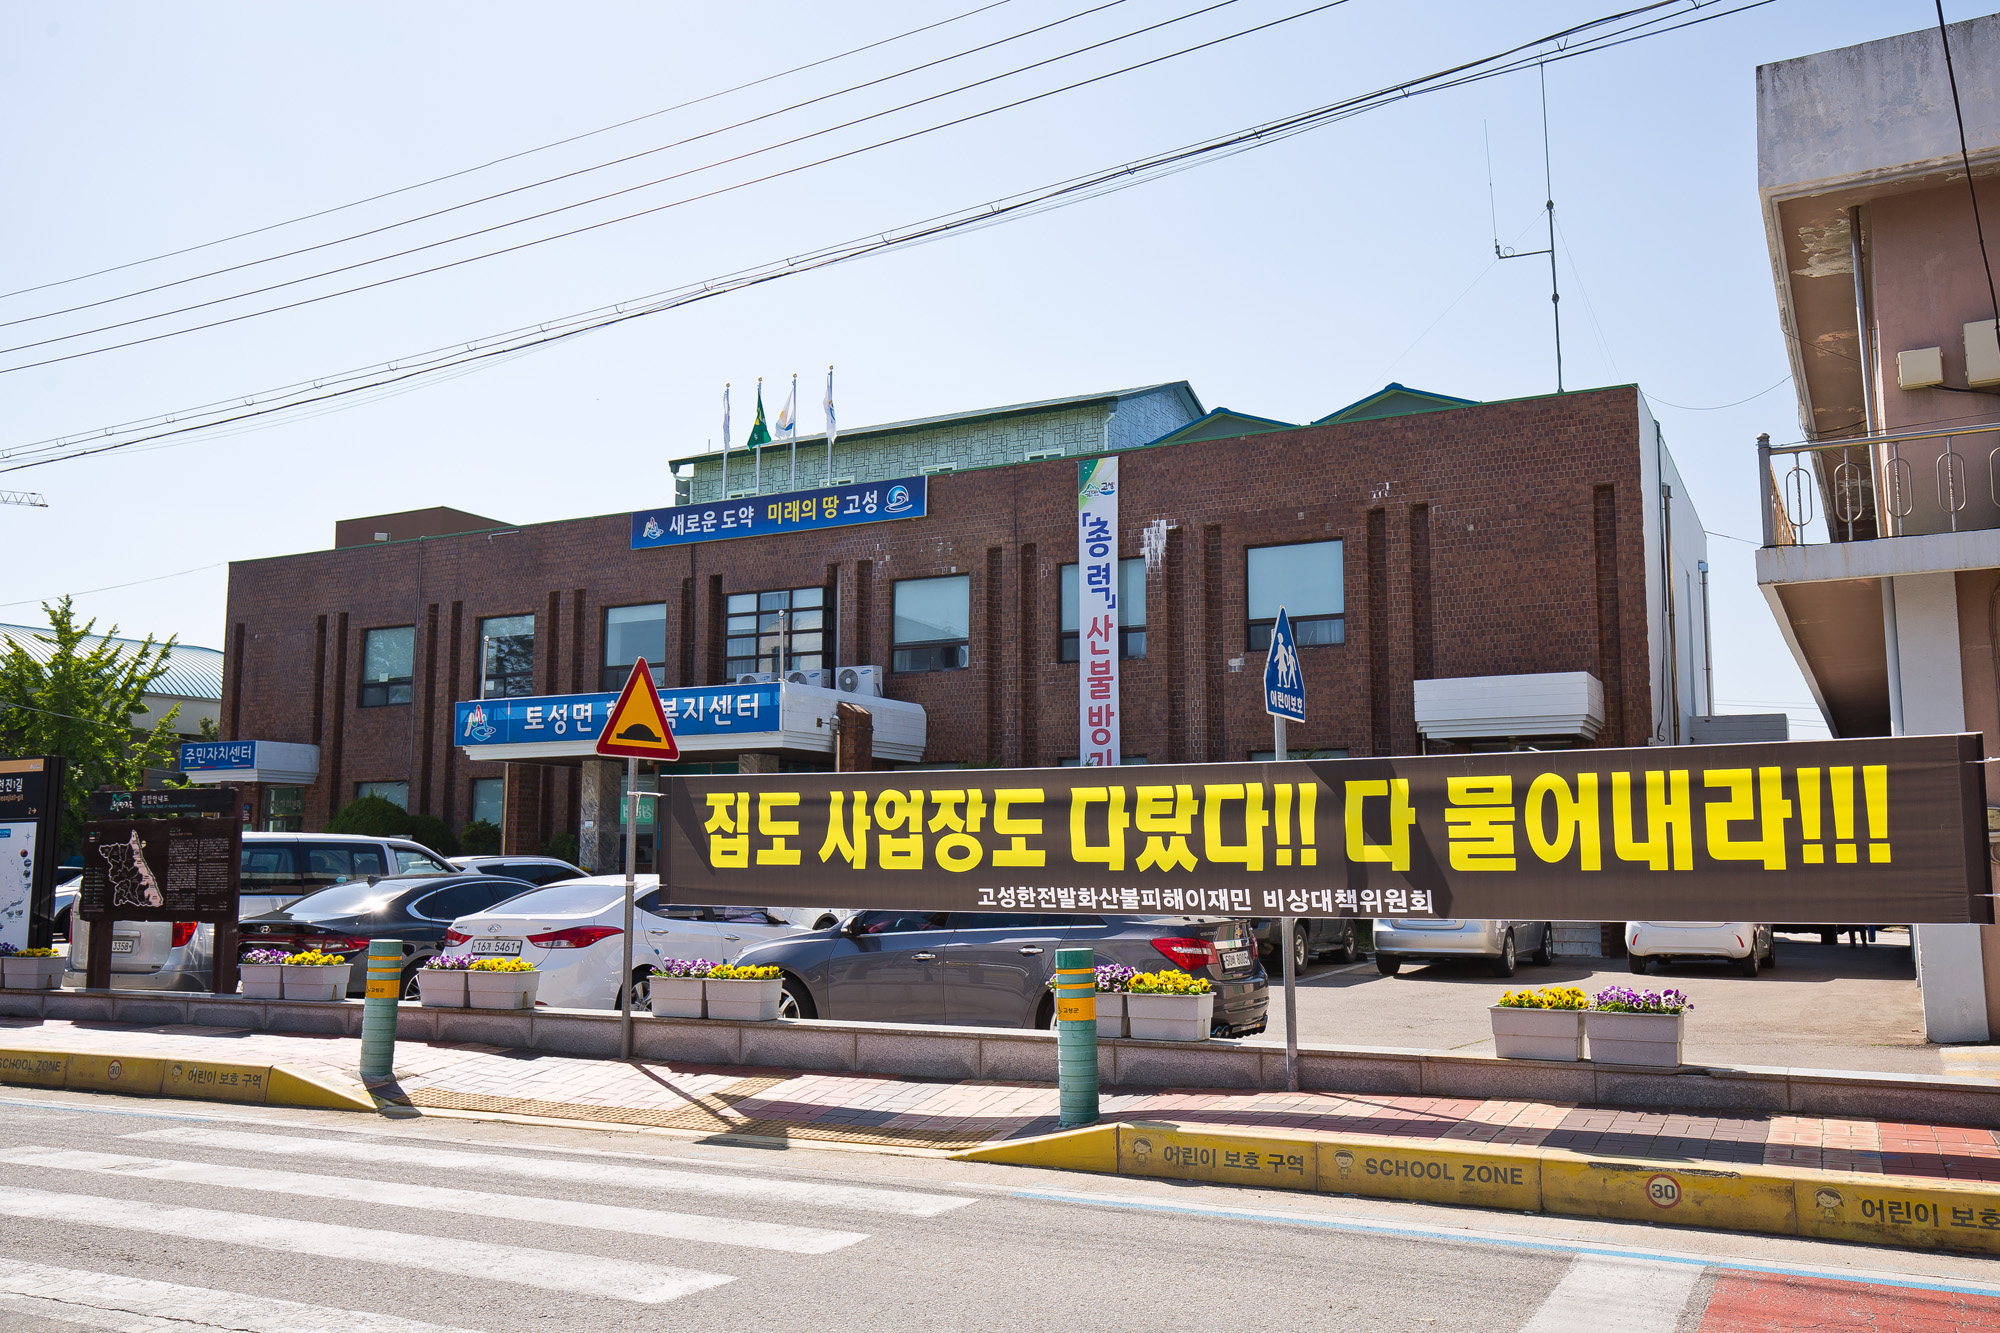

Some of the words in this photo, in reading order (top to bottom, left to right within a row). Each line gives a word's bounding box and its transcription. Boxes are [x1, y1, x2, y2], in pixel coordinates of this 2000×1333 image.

[669, 510, 717, 536] 새로운
[721, 506, 754, 529] 도약
[768, 497, 817, 525] 미래의
[822, 495, 839, 518] 땅
[843, 490, 879, 515] 고성
[524, 702, 593, 735] 토성면
[606, 693, 760, 729] 복지센터
[1270, 690, 1304, 714] 어린이보호
[184, 745, 252, 764] 주민자치센터
[704, 791, 801, 869] 집도
[818, 788, 1046, 873] 사업장도
[1069, 782, 1318, 873] 다탔다!!
[1344, 778, 1416, 872] 다
[1445, 764, 1892, 872] 물어내라!!!
[978, 886, 1251, 912] 고성한전발화산불피해이재민
[1263, 888, 1434, 914] 비상대책위원회
[495, 942, 515, 951] 5461
[35, 1060, 61, 1073] ZONE
[110, 1066, 119, 1076] 30
[187, 1068, 217, 1086] 어린이
[218, 1072, 239, 1085] 보호
[242, 1073, 263, 1089] 구역
[1163, 1146, 1217, 1168] 어린이
[1223, 1151, 1261, 1170] 보호
[1267, 1154, 1304, 1175] 구역
[1365, 1158, 1455, 1181] SCHOOL
[1462, 1164, 1523, 1185] ZONE
[1651, 1184, 1675, 1199] 30
[1861, 1199, 1939, 1227] 어린이
[1950, 1206, 2000, 1231] 보호
